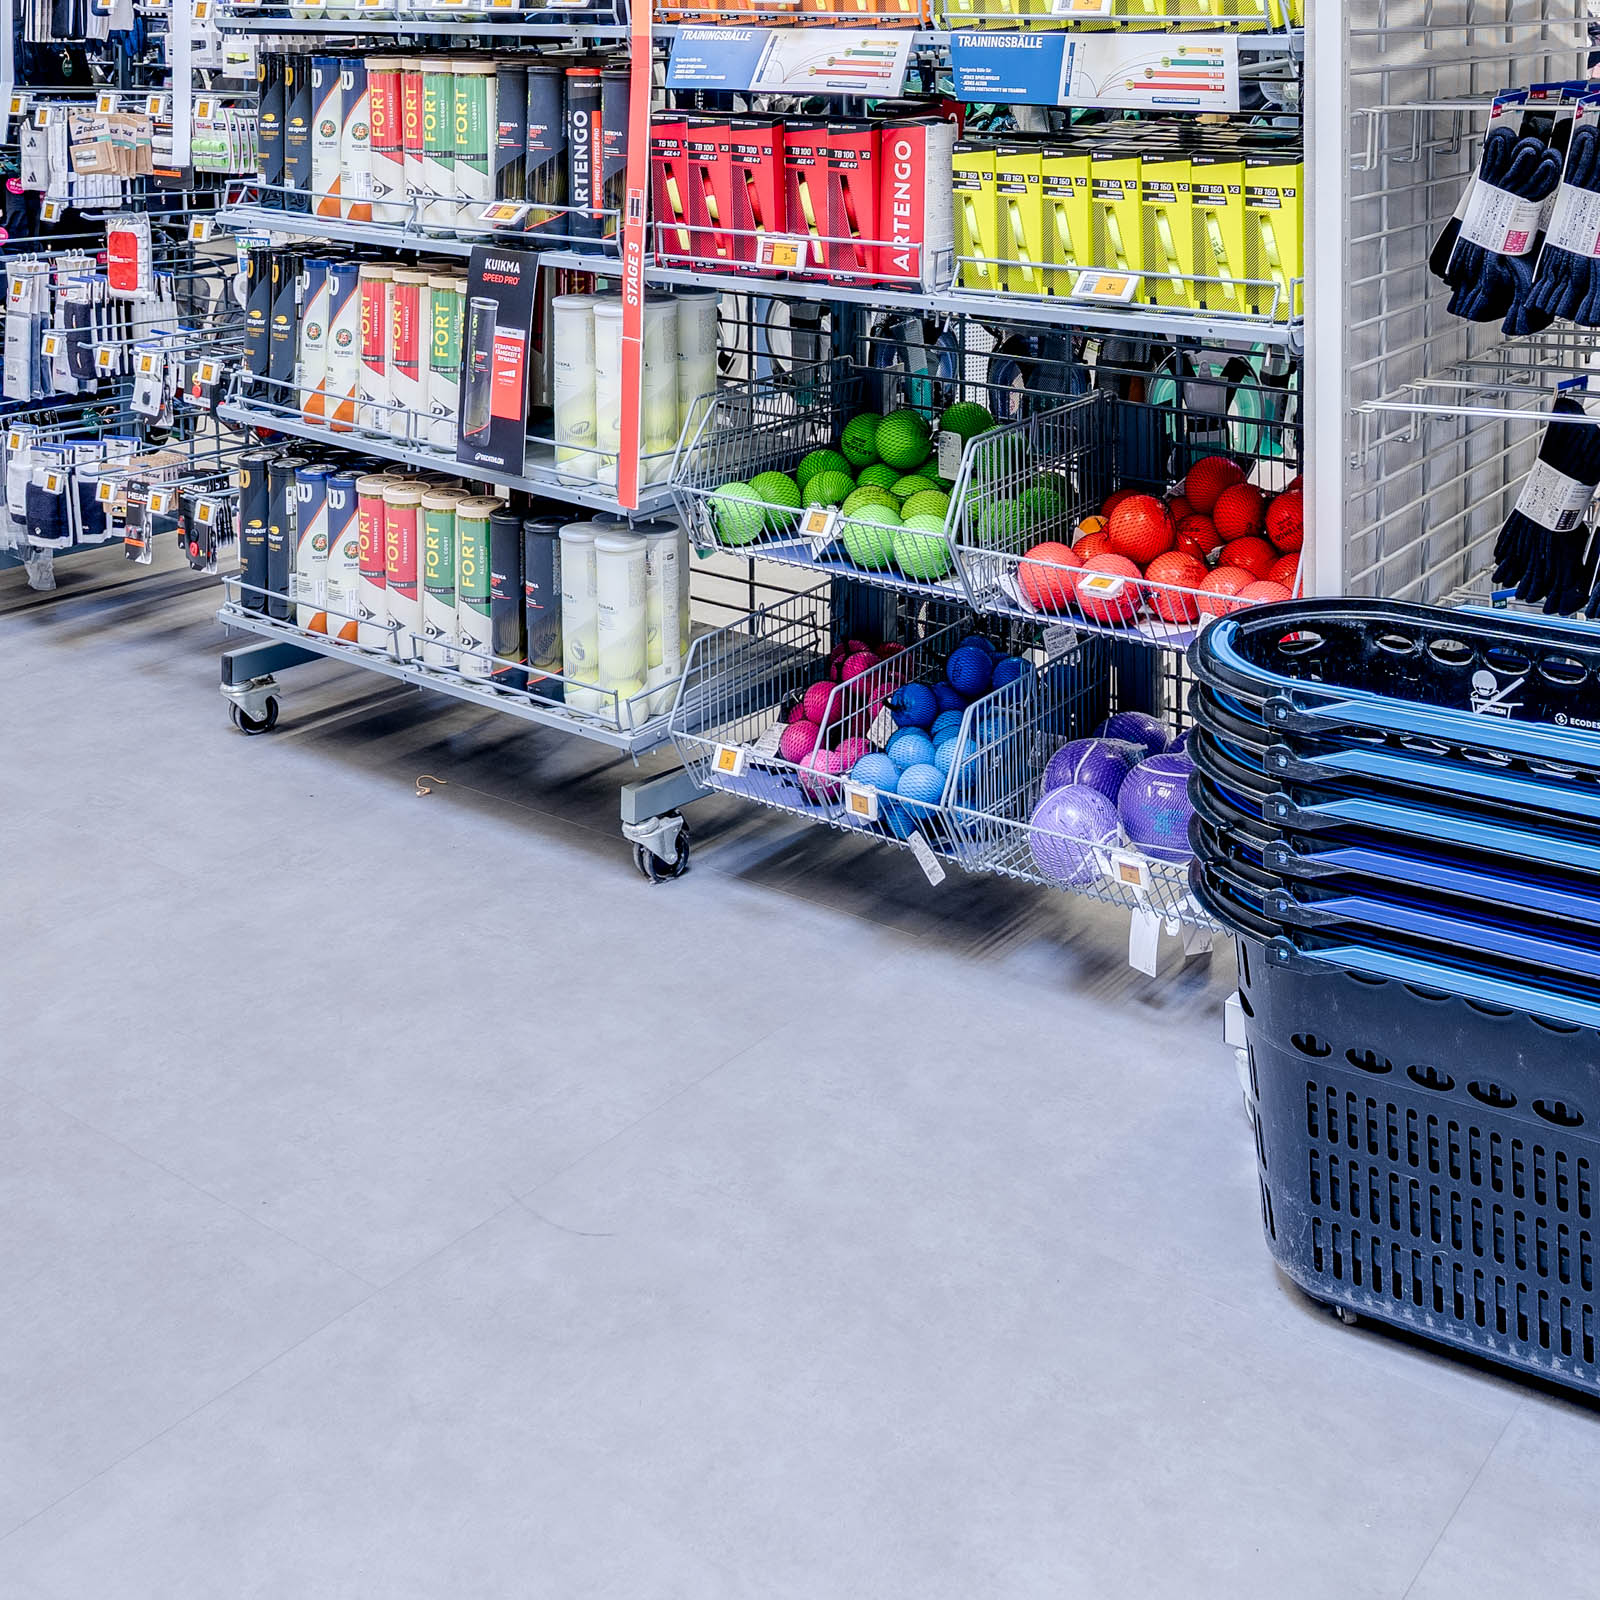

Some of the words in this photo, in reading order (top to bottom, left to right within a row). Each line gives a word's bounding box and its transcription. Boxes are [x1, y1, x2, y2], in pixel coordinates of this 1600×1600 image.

[681, 30, 753, 42] TRAININGSBÄLLE
[958, 35, 1043, 49] TRAININGSBÄLLE
[573, 110, 588, 219] ARTENGO
[893, 140, 912, 272] ARTENGO
[629, 242, 639, 253] 3
[485, 258, 521, 274] KUIKMA
[482, 272, 504, 284] SPEED
[627, 256, 639, 307] STAGE
[434, 302, 449, 357] FORT
[128, 491, 149, 501] HEAD
[461, 532, 475, 588] FORT
